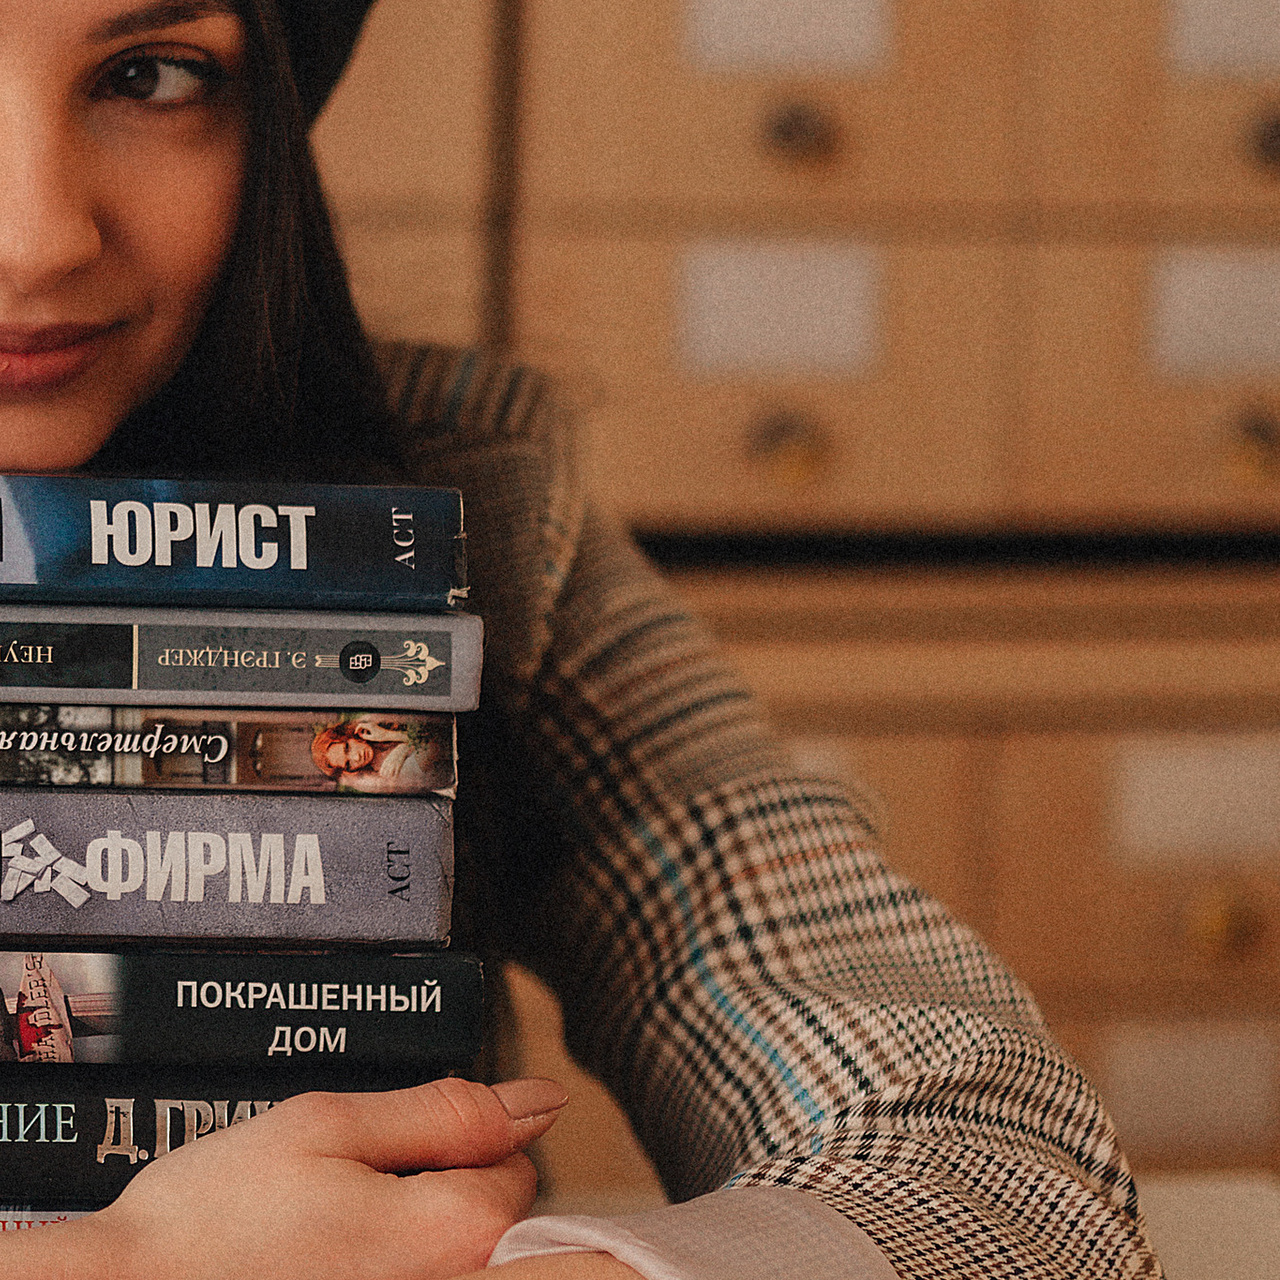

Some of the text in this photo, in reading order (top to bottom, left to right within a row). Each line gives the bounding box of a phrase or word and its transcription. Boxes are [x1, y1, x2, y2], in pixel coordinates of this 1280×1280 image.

[90, 499, 316, 570] ЮРИСТ
[391, 506, 416, 570] АСТ
[157, 645, 308, 669] Э. ГРЭНДЖЕР
[85, 829, 326, 905] ФИРМА
[387, 841, 411, 903] АСТ
[176, 978, 442, 1013] ПОКРАШЕННЫЙ
[267, 1025, 348, 1057] ДОМ
